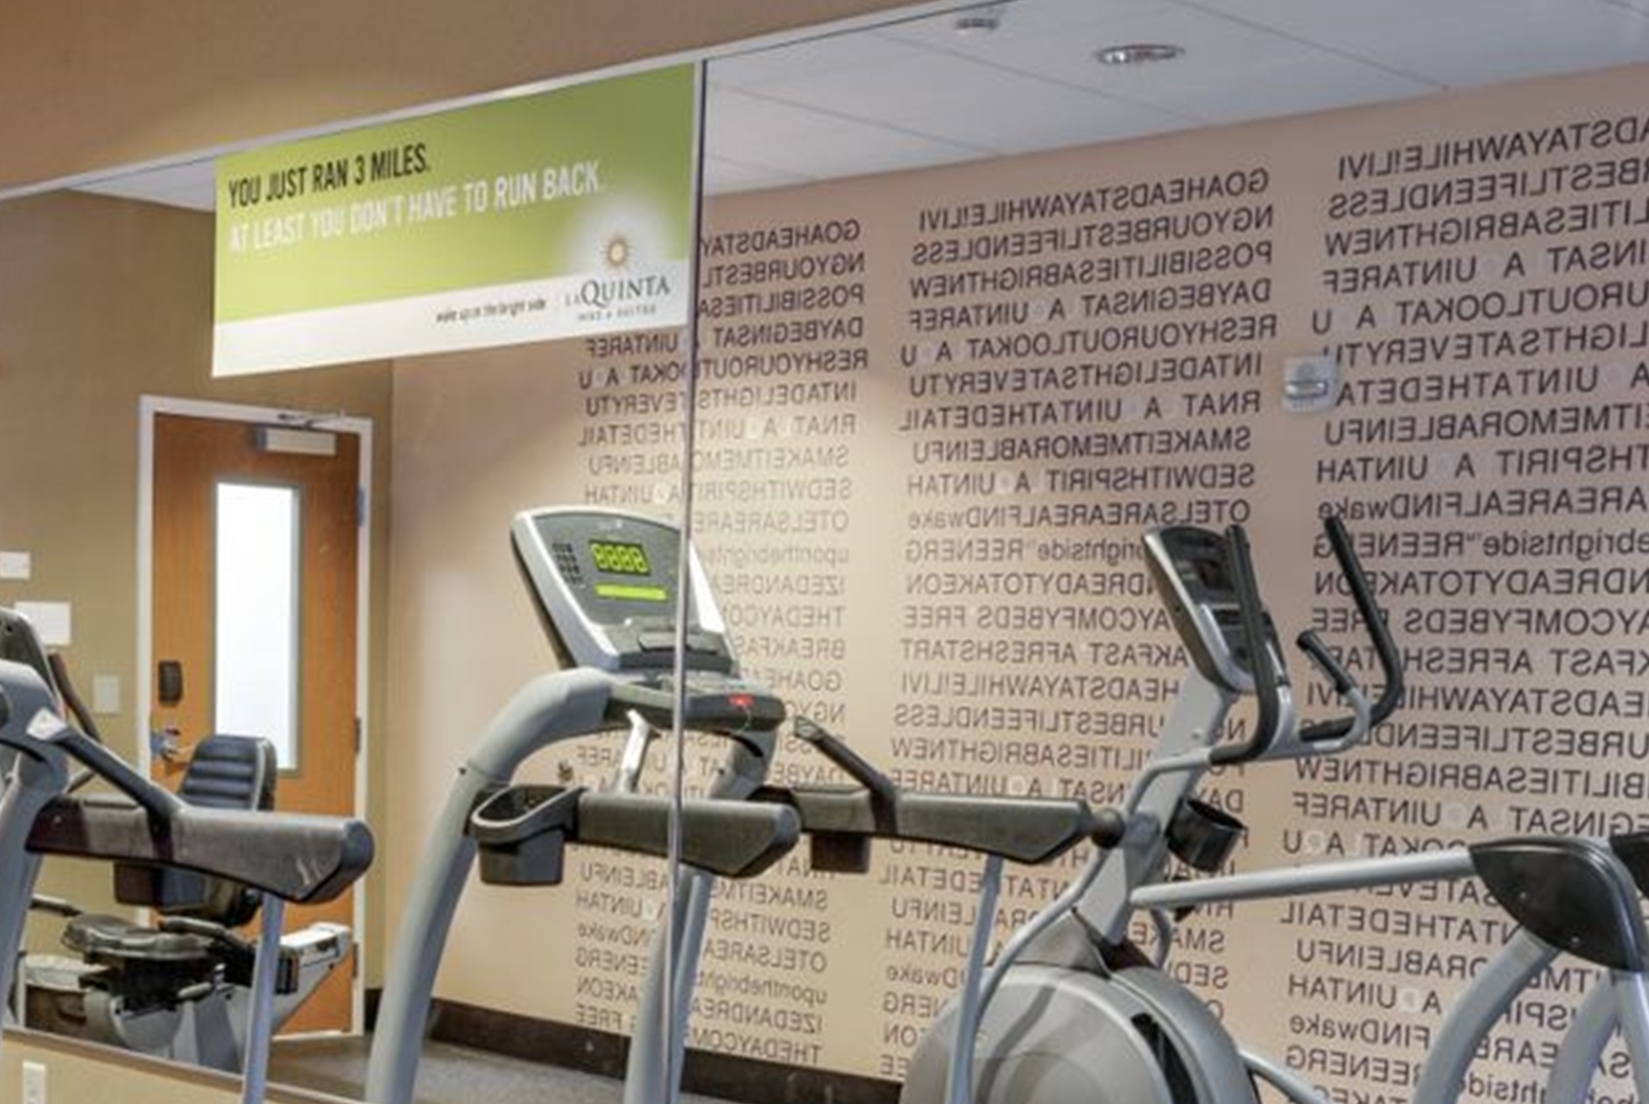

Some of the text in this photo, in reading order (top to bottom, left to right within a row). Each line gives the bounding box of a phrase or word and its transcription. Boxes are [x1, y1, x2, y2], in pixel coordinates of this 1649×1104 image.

[229, 143, 431, 208] YOU JUST RAN 3 MILES.
[229, 222, 249, 256] AT
[255, 212, 305, 249] LEAST
[311, 207, 343, 239] YOU
[408, 185, 457, 222] HAVE
[464, 180, 487, 213] TO
[494, 172, 536, 211] RUN
[543, 160, 604, 200] BACK.
[580, 275, 671, 308] QUINTA
